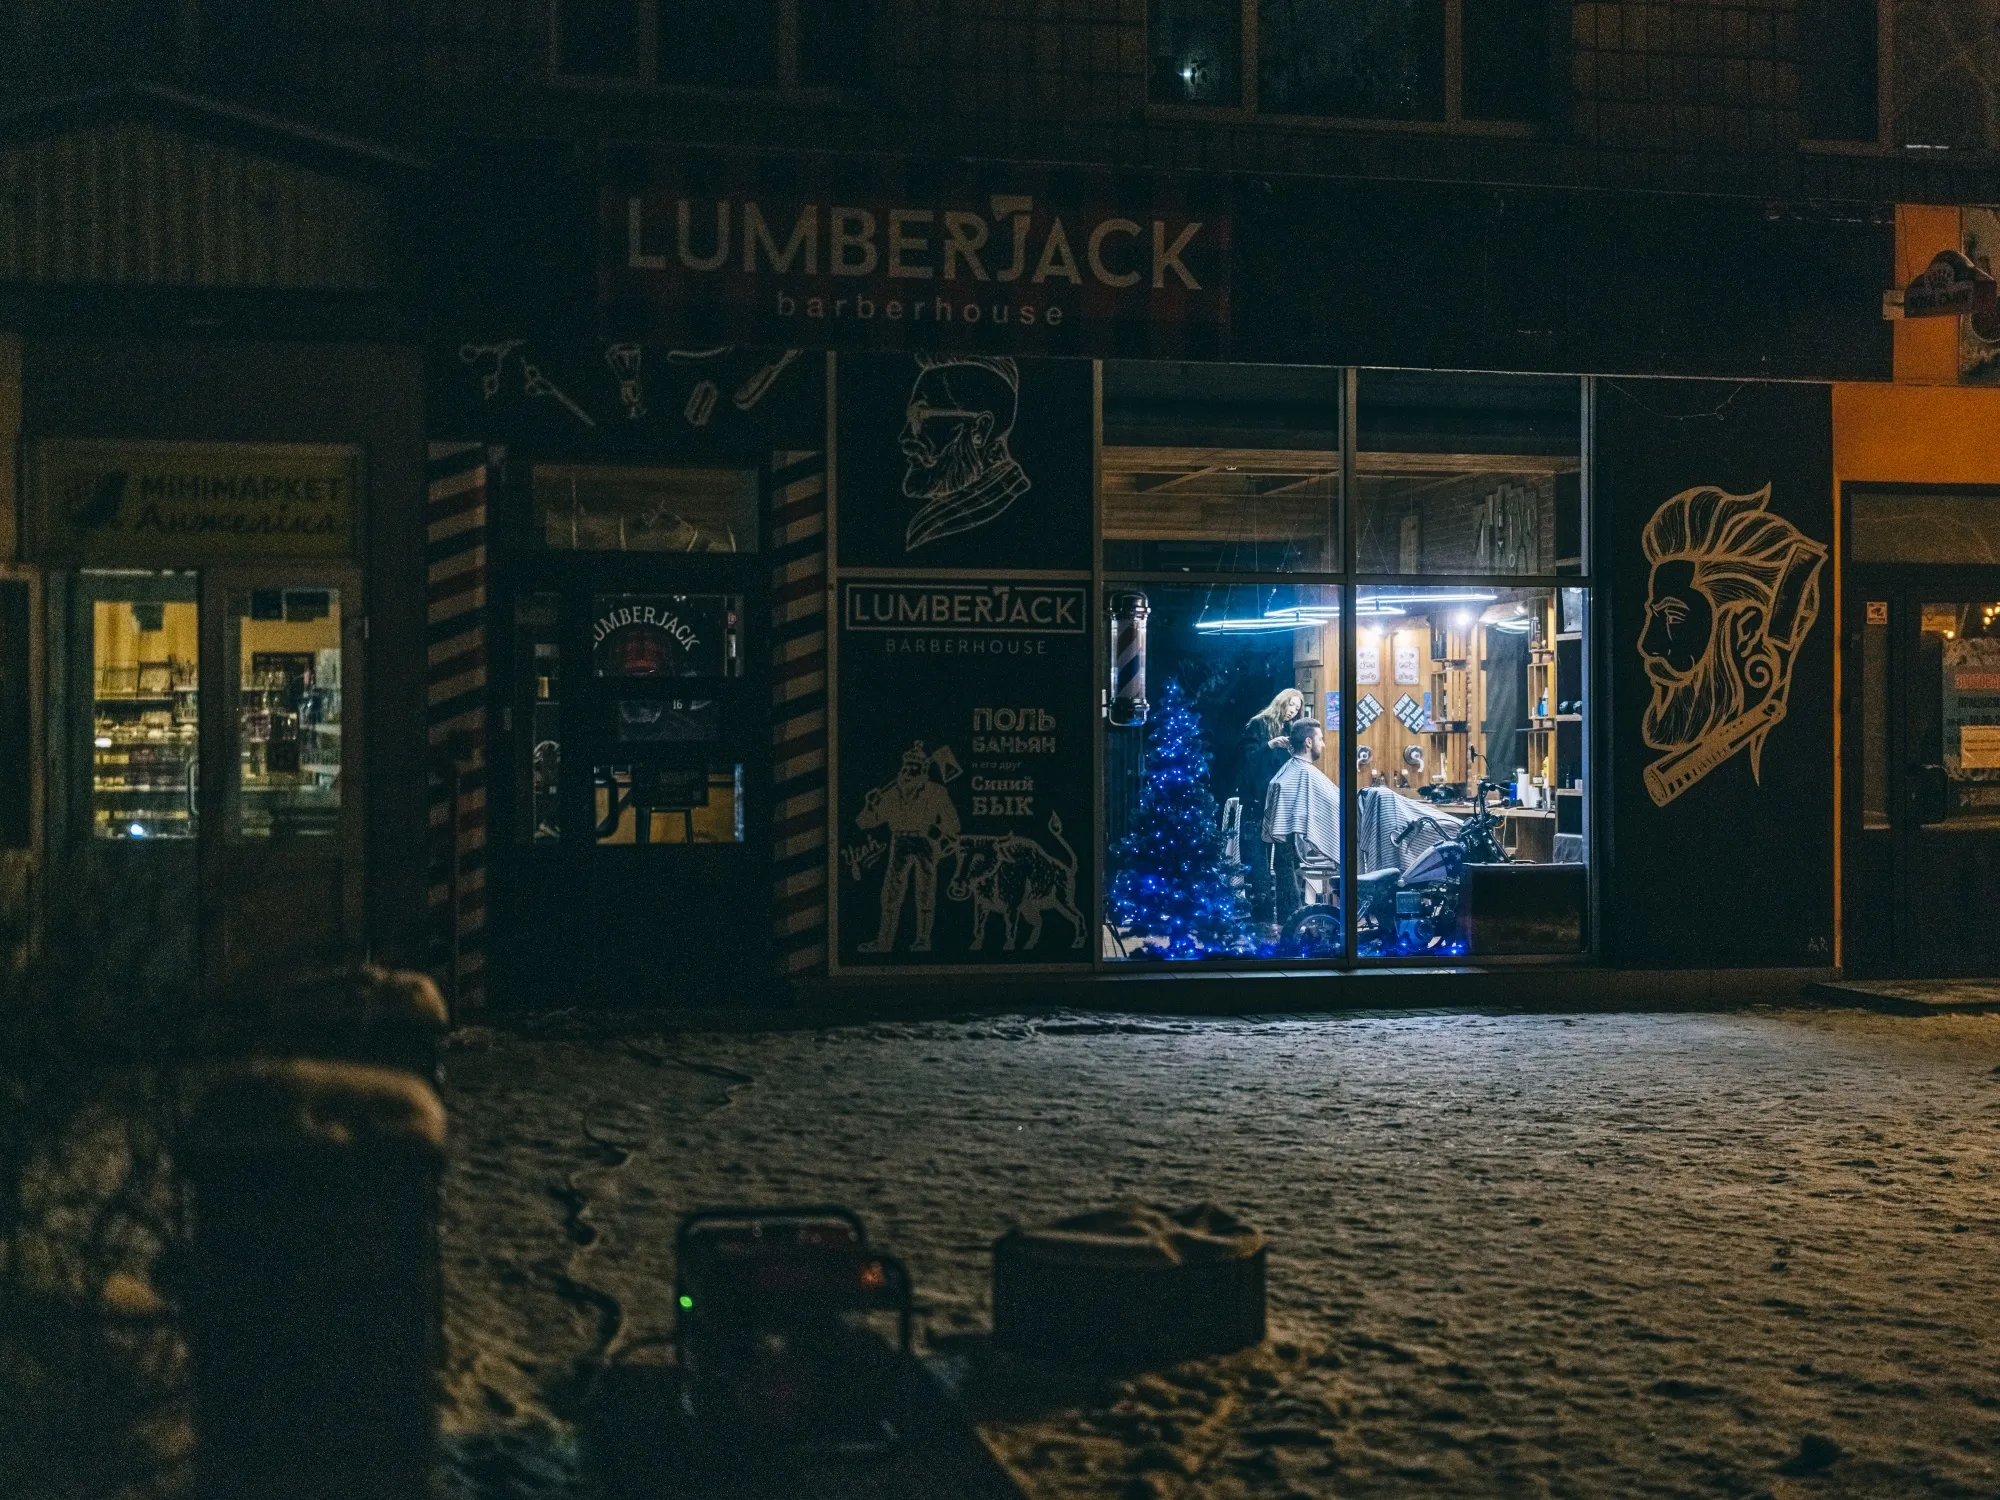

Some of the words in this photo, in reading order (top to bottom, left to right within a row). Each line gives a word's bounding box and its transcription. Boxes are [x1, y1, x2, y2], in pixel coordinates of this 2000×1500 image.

[627, 194, 1204, 292] LUMBERJACK
[777, 290, 1064, 327] barberhouse
[854, 586, 1077, 625] LUMBERJACK
[593, 606, 700, 652] UMBERJACK
[885, 638, 1047, 655] BARBERHOUSE
[1359, 700, 1377, 720] hard
[1364, 693, 1385, 716] WORK
[973, 707, 1057, 732] ПОЛЬ
[972, 736, 1056, 753] БАНЬЯН
[972, 796, 1034, 816] БЫК
